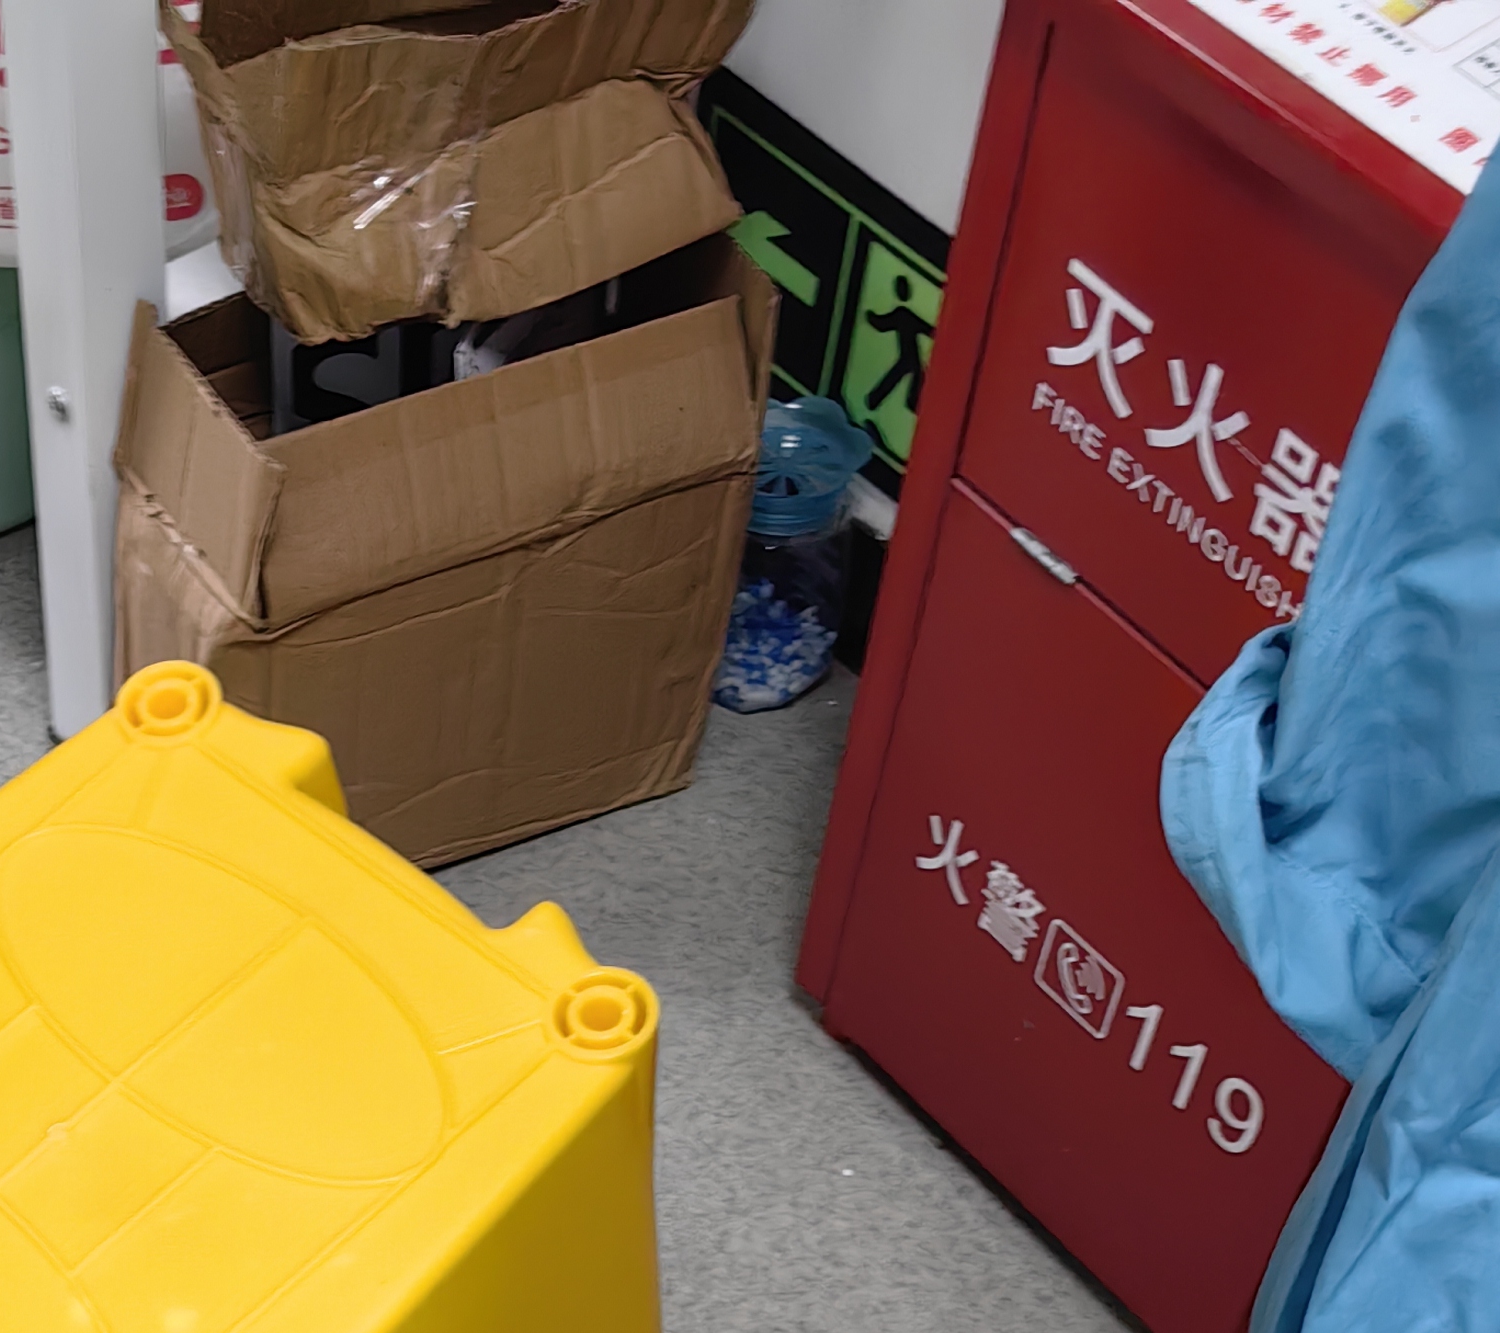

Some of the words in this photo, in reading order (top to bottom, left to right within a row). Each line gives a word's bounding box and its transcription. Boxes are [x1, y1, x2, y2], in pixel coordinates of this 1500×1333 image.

[1031, 381, 1107, 460] FIRE
[1046, 258, 1341, 574] 灭火器
[915, 814, 1047, 962] 火警
[1125, 1003, 1265, 1154] 119
